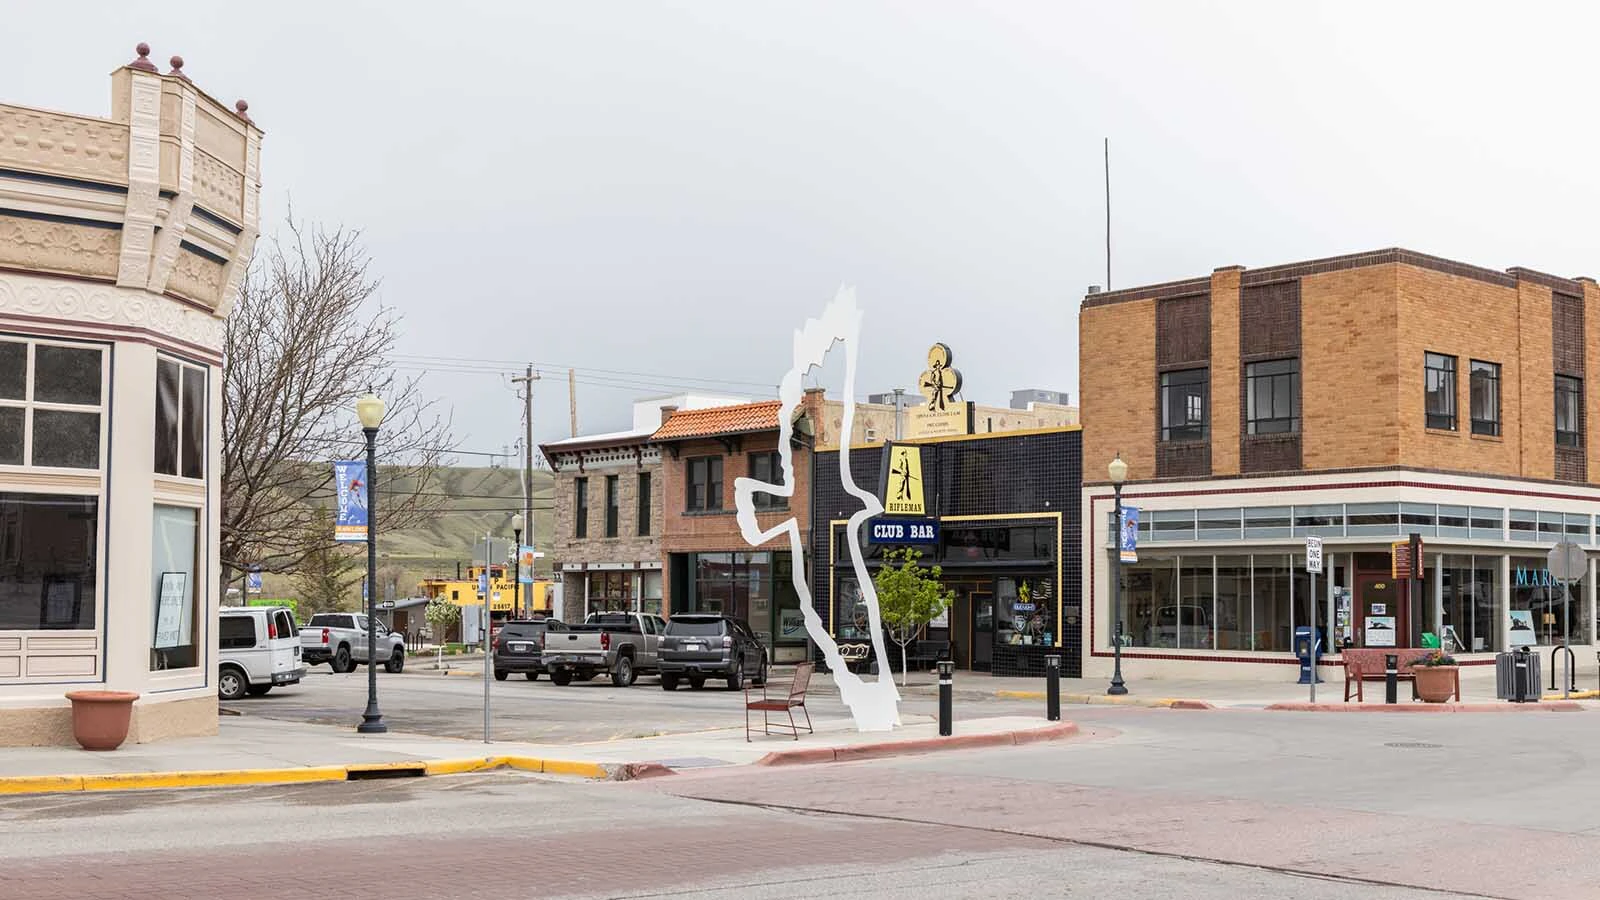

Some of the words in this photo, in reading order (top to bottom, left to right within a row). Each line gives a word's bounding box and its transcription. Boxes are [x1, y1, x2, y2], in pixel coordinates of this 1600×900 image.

[337, 465, 348, 521] WELCOME
[889, 503, 922, 512] RIFLEMAN
[874, 524, 904, 538] CLUB
[910, 525, 935, 539] BAR
[1309, 549, 1320, 559] ONE
[1309, 560, 1320, 569] WAY
